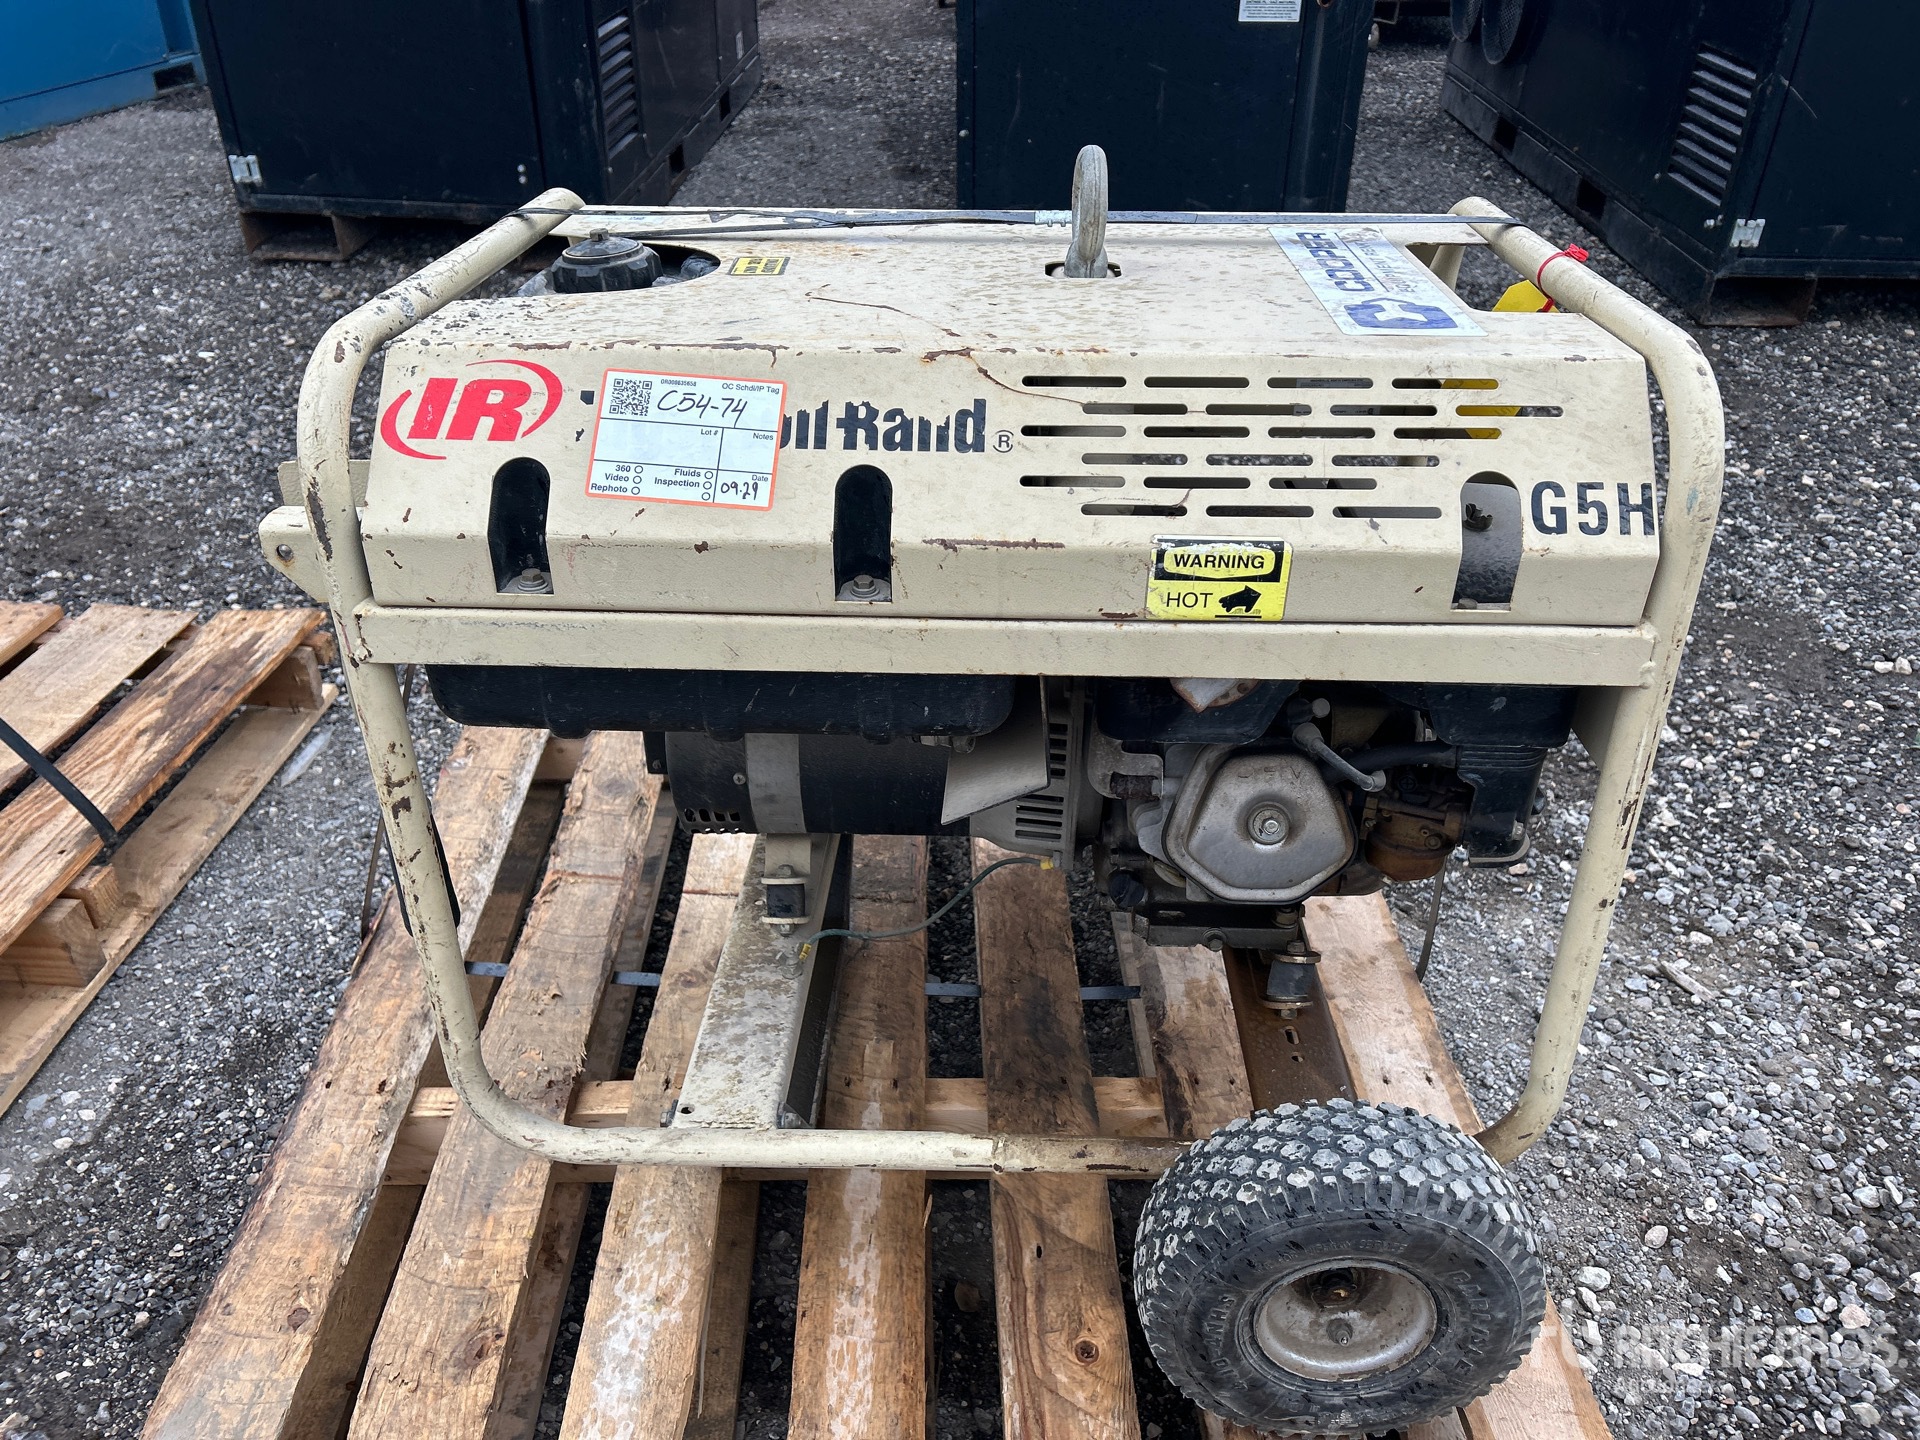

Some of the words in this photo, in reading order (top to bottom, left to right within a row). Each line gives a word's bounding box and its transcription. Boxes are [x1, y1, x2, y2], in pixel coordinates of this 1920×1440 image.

[1295, 232, 1375, 291] COOPER
[767, 386, 780, 395] Tag
[407, 378, 532, 441] IR
[657, 390, 748, 428] C54-74
[753, 432, 774, 440] Notes
[615, 465, 631, 473] 360
[674, 468, 701, 477] Fluids
[605, 473, 630, 482] Video
[654, 477, 700, 488] Inspection
[752, 474, 769, 482] Date
[591, 483, 628, 493] Rephoto
[1531, 480, 1655, 536] G5H
[1174, 554, 1265, 569] WARNING
[1166, 592, 1213, 608] HOT
